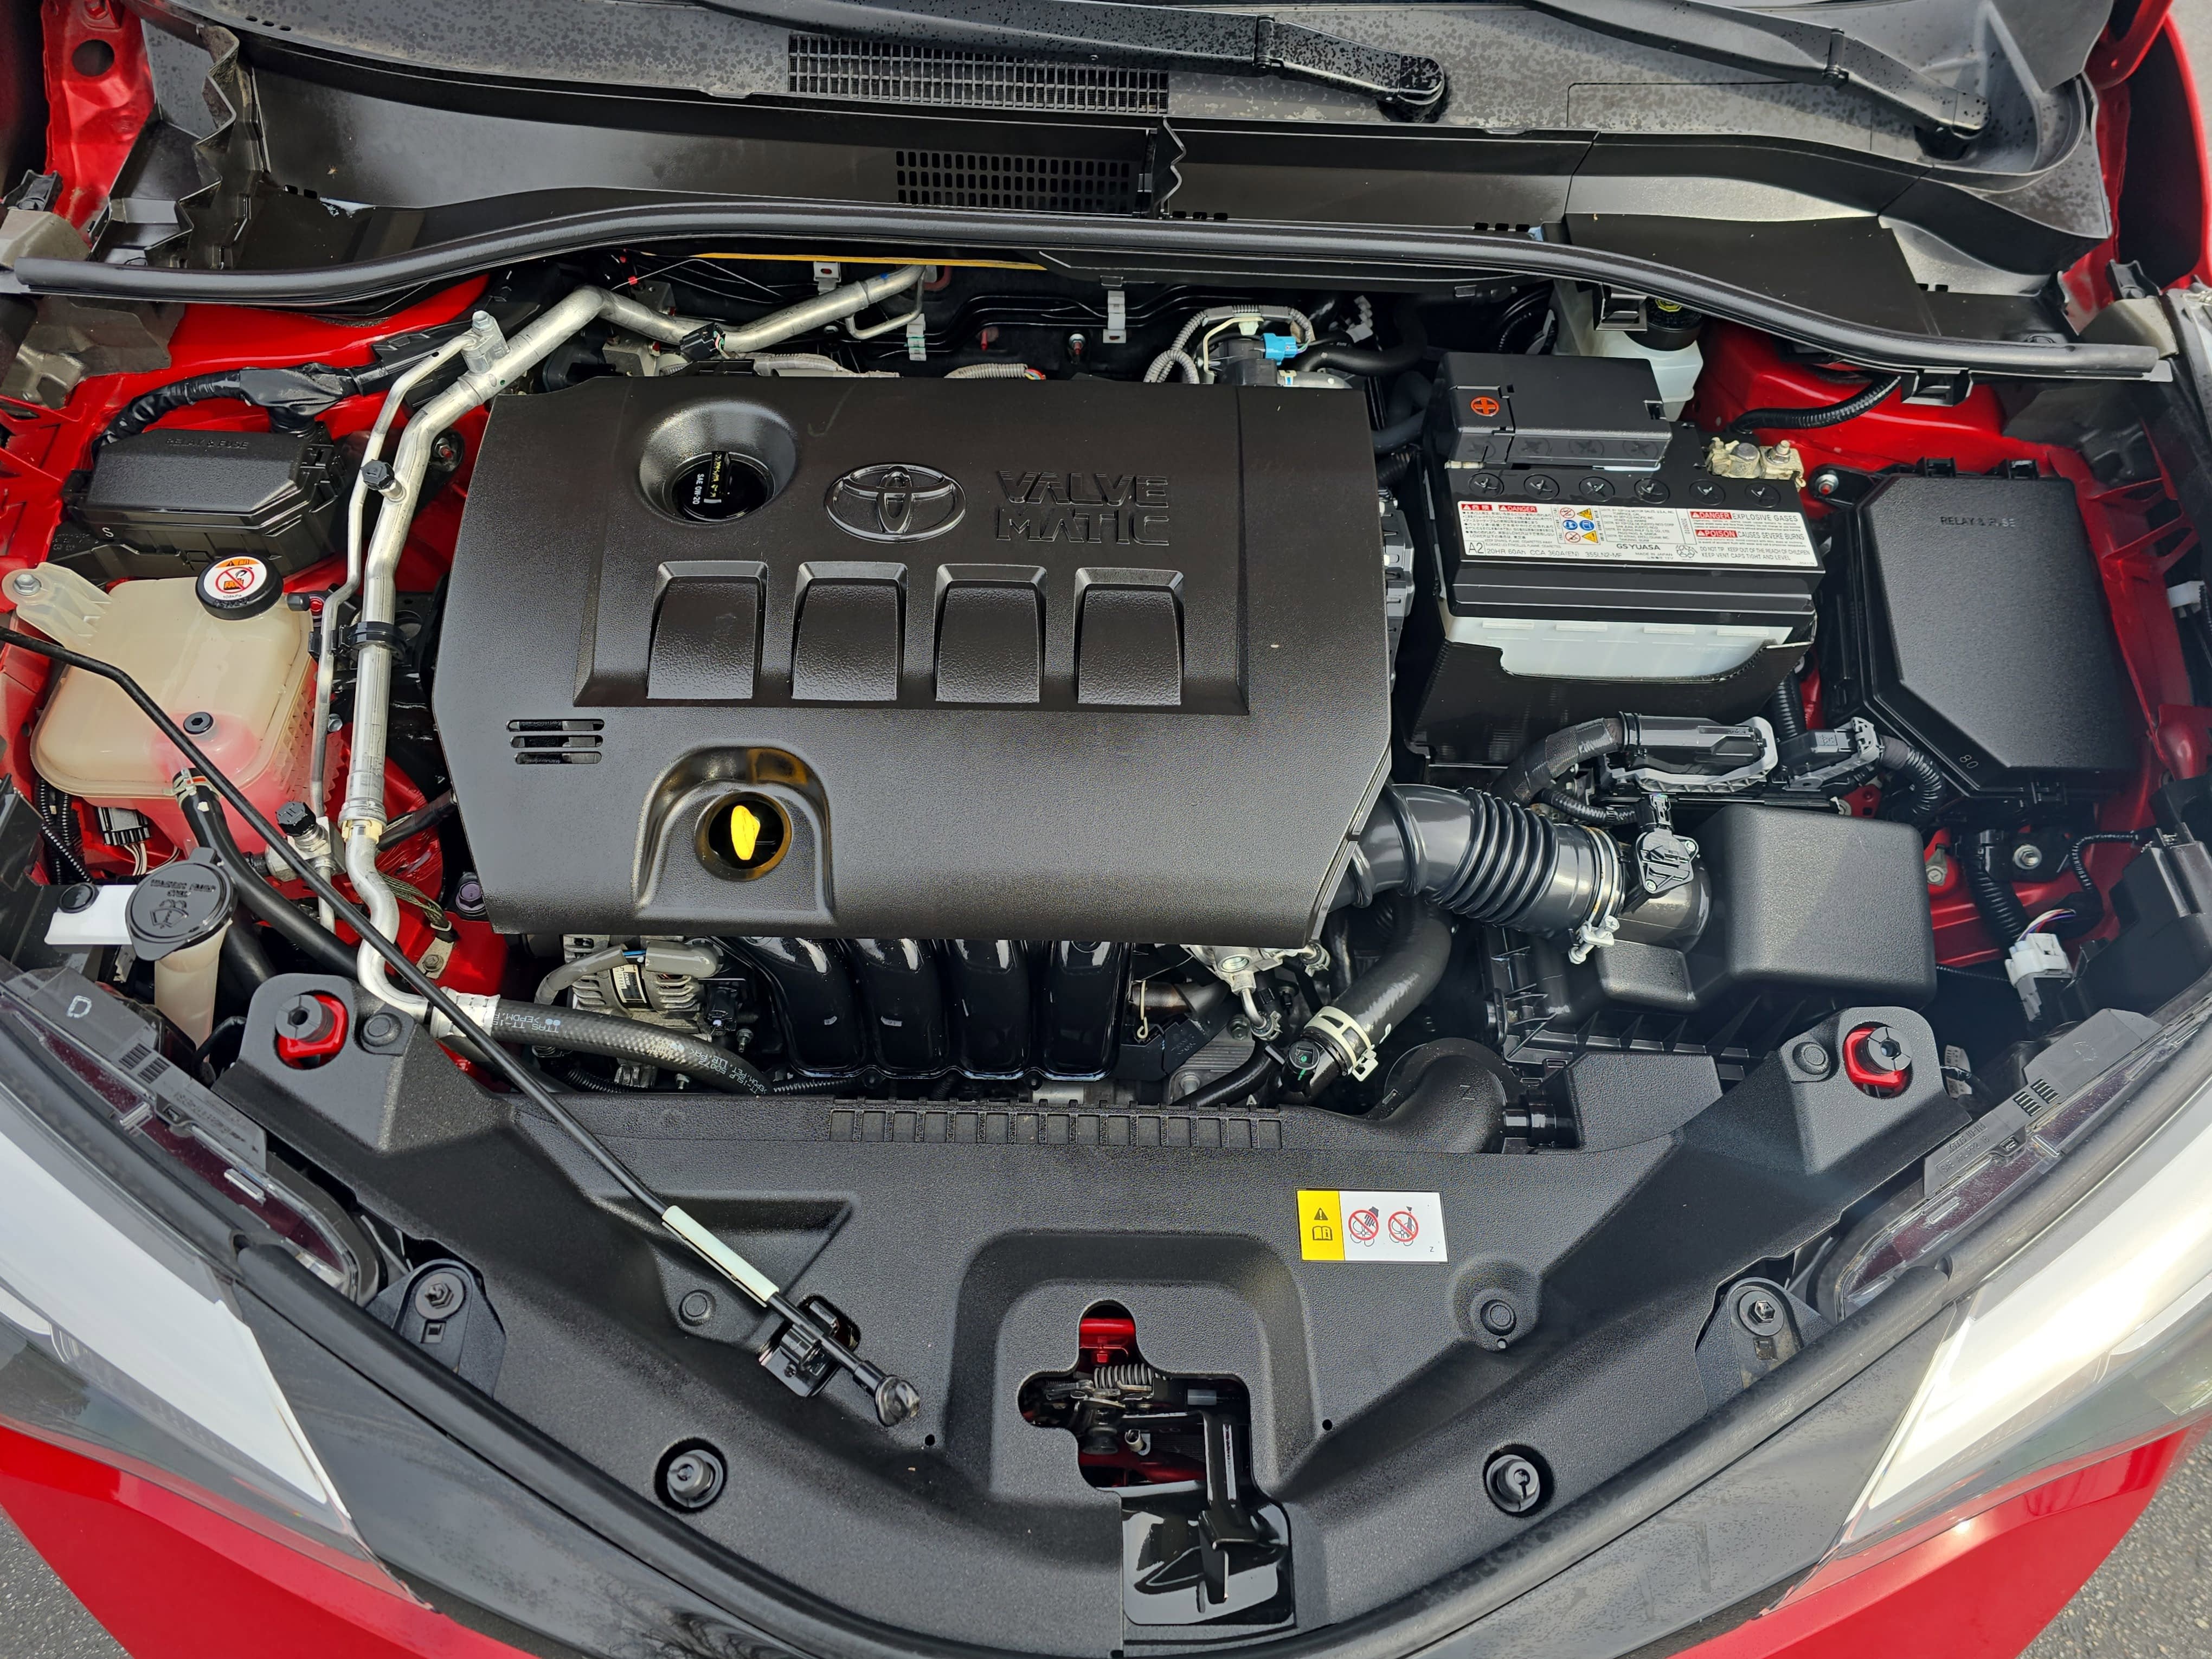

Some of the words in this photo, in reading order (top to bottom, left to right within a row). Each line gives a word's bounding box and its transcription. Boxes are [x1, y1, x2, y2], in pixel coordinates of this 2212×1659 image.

[696, 473, 704, 485] SAE
[996, 471, 1169, 507] VALVE
[1733, 513, 1772, 521] EXPLOSIVE
[1939, 516, 1975, 525] RELAY
[102, 527, 114, 537] S
[996, 507, 1169, 546] MATIC
[1468, 542, 1484, 554] A2
[68, 995, 92, 1019] D
[531, 1024, 560, 1033] TTAS
[1246, 1094, 1257, 1106] A
[1940, 1159, 1956, 1172] SAE
